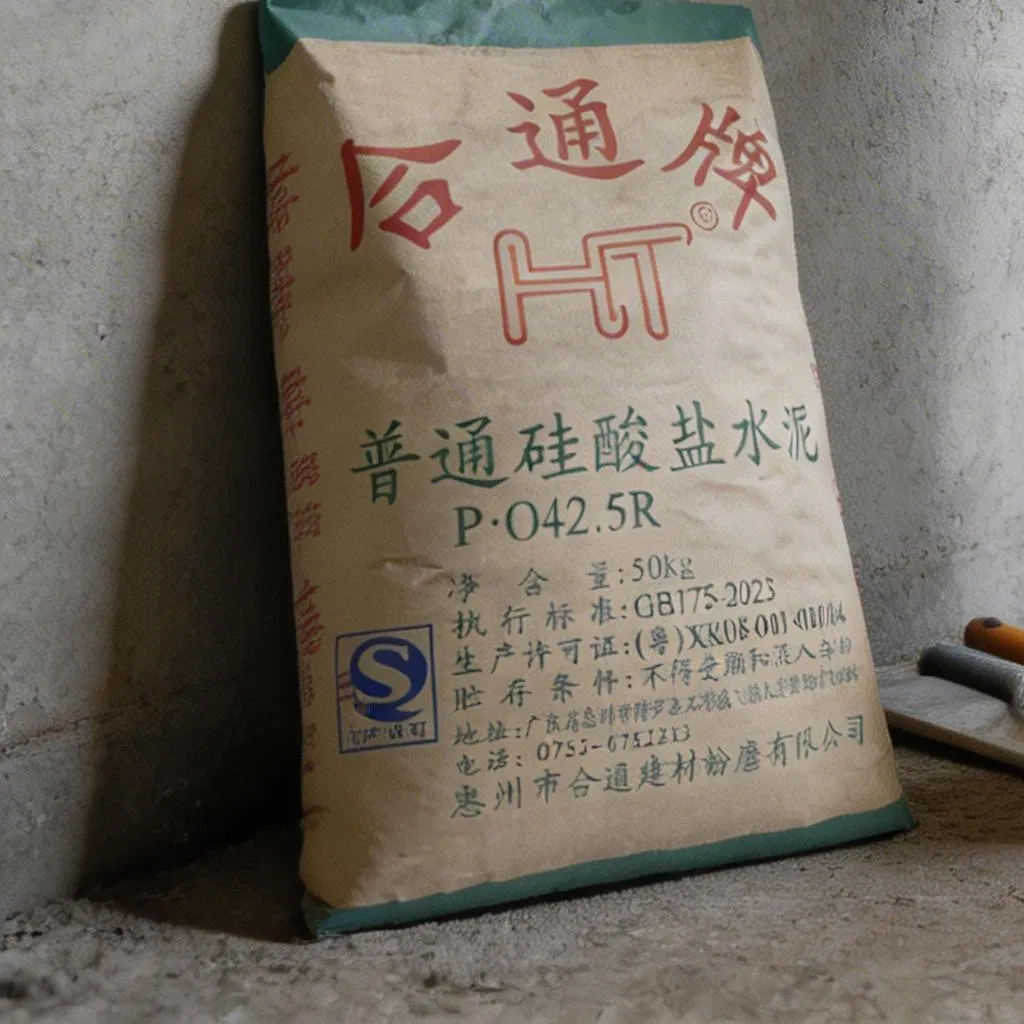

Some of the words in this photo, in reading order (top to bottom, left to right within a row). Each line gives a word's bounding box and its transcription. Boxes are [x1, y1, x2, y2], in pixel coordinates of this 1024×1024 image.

[350, 399, 818, 505] 普通硅酸盐水泥
